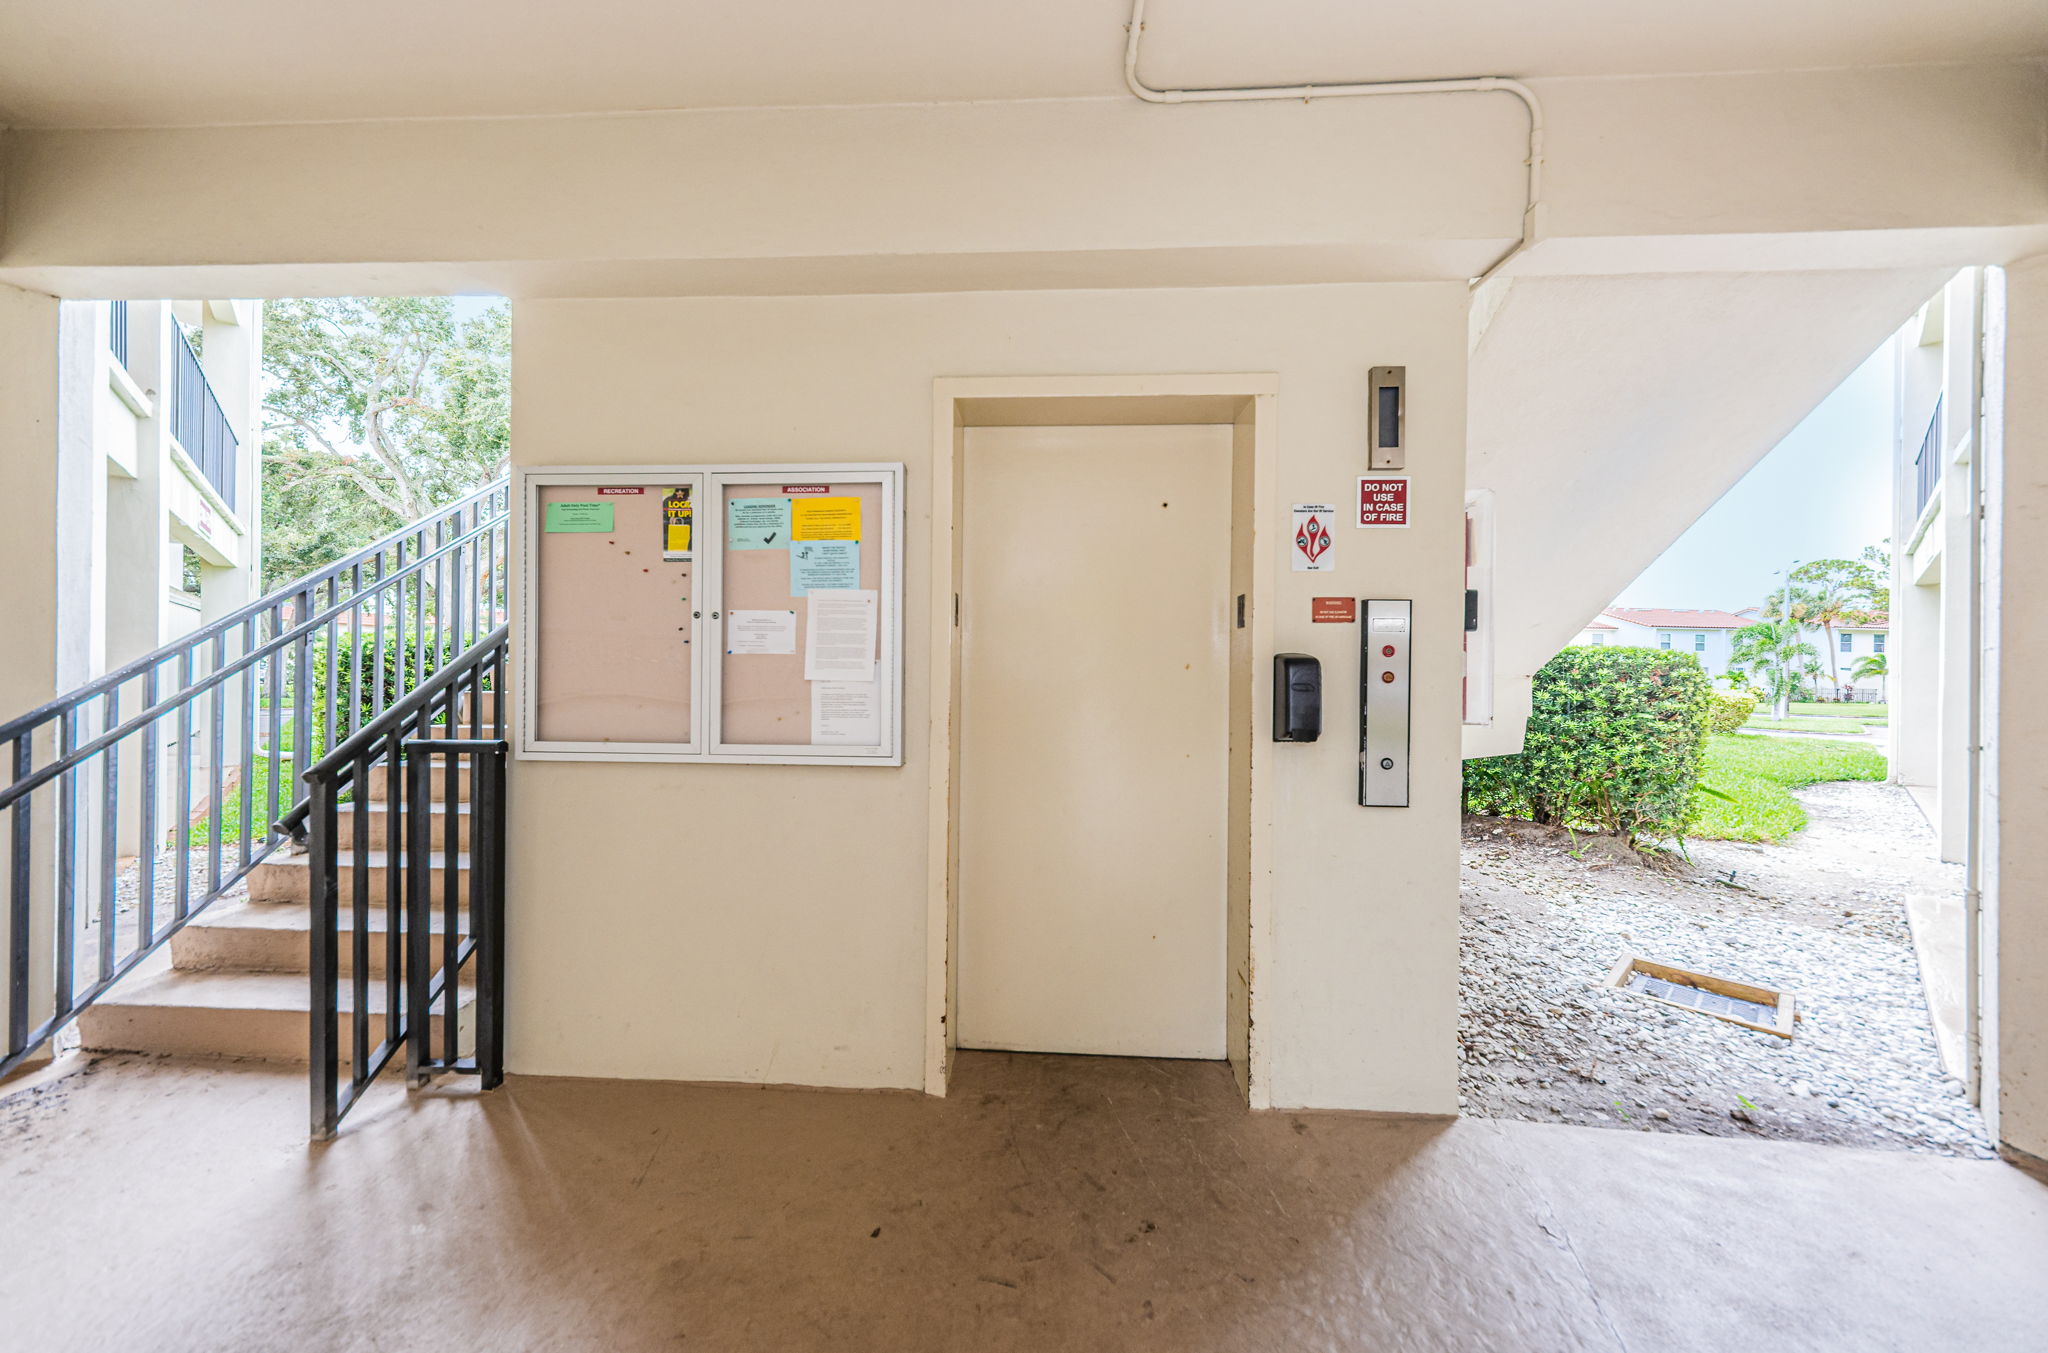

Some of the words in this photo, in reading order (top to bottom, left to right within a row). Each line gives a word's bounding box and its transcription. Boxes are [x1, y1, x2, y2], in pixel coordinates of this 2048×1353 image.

[1364, 483, 1380, 492] DO
[1381, 483, 1404, 492] NOT
[1373, 493, 1395, 502] USE
[1363, 503, 1374, 512] IN
[1375, 503, 1405, 512] CASE
[1363, 513, 1378, 521] OF
[1380, 513, 1404, 521] FIRE
